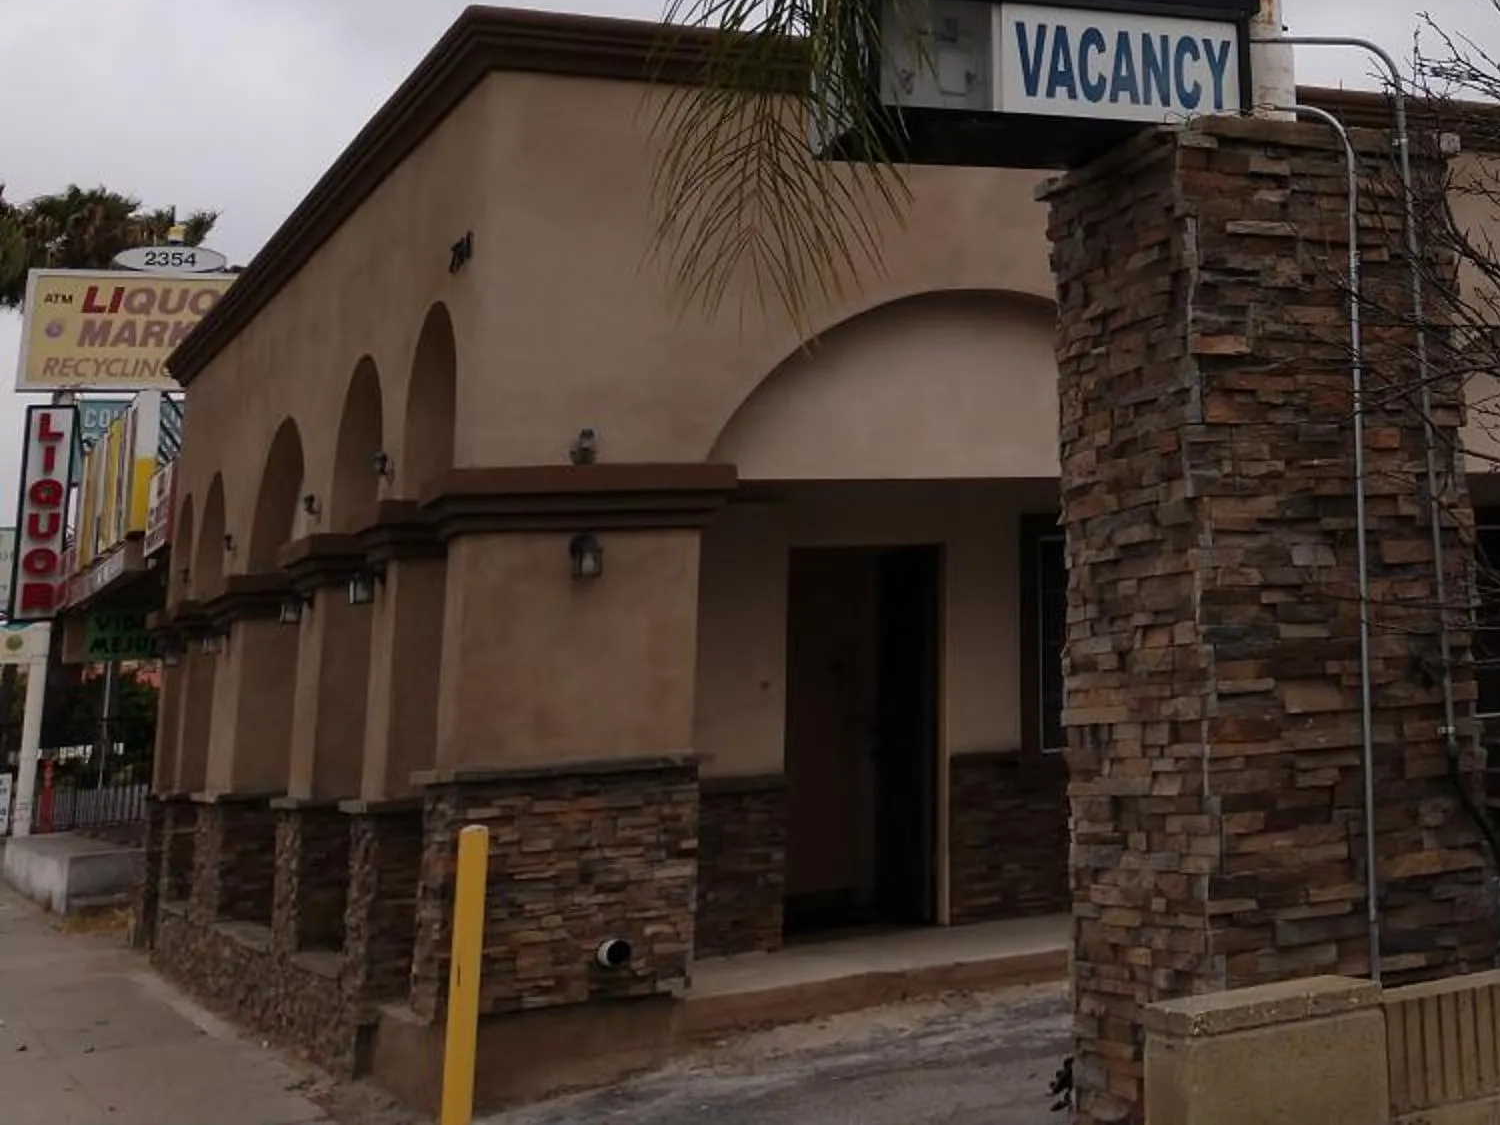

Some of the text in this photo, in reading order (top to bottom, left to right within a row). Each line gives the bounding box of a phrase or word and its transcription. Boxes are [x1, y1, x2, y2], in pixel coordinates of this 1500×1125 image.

[1014, 20, 1231, 111] VACANCY
[143, 251, 197, 268] 2354
[44, 293, 73, 304] ATM
[21, 412, 65, 613] LIQUOR
